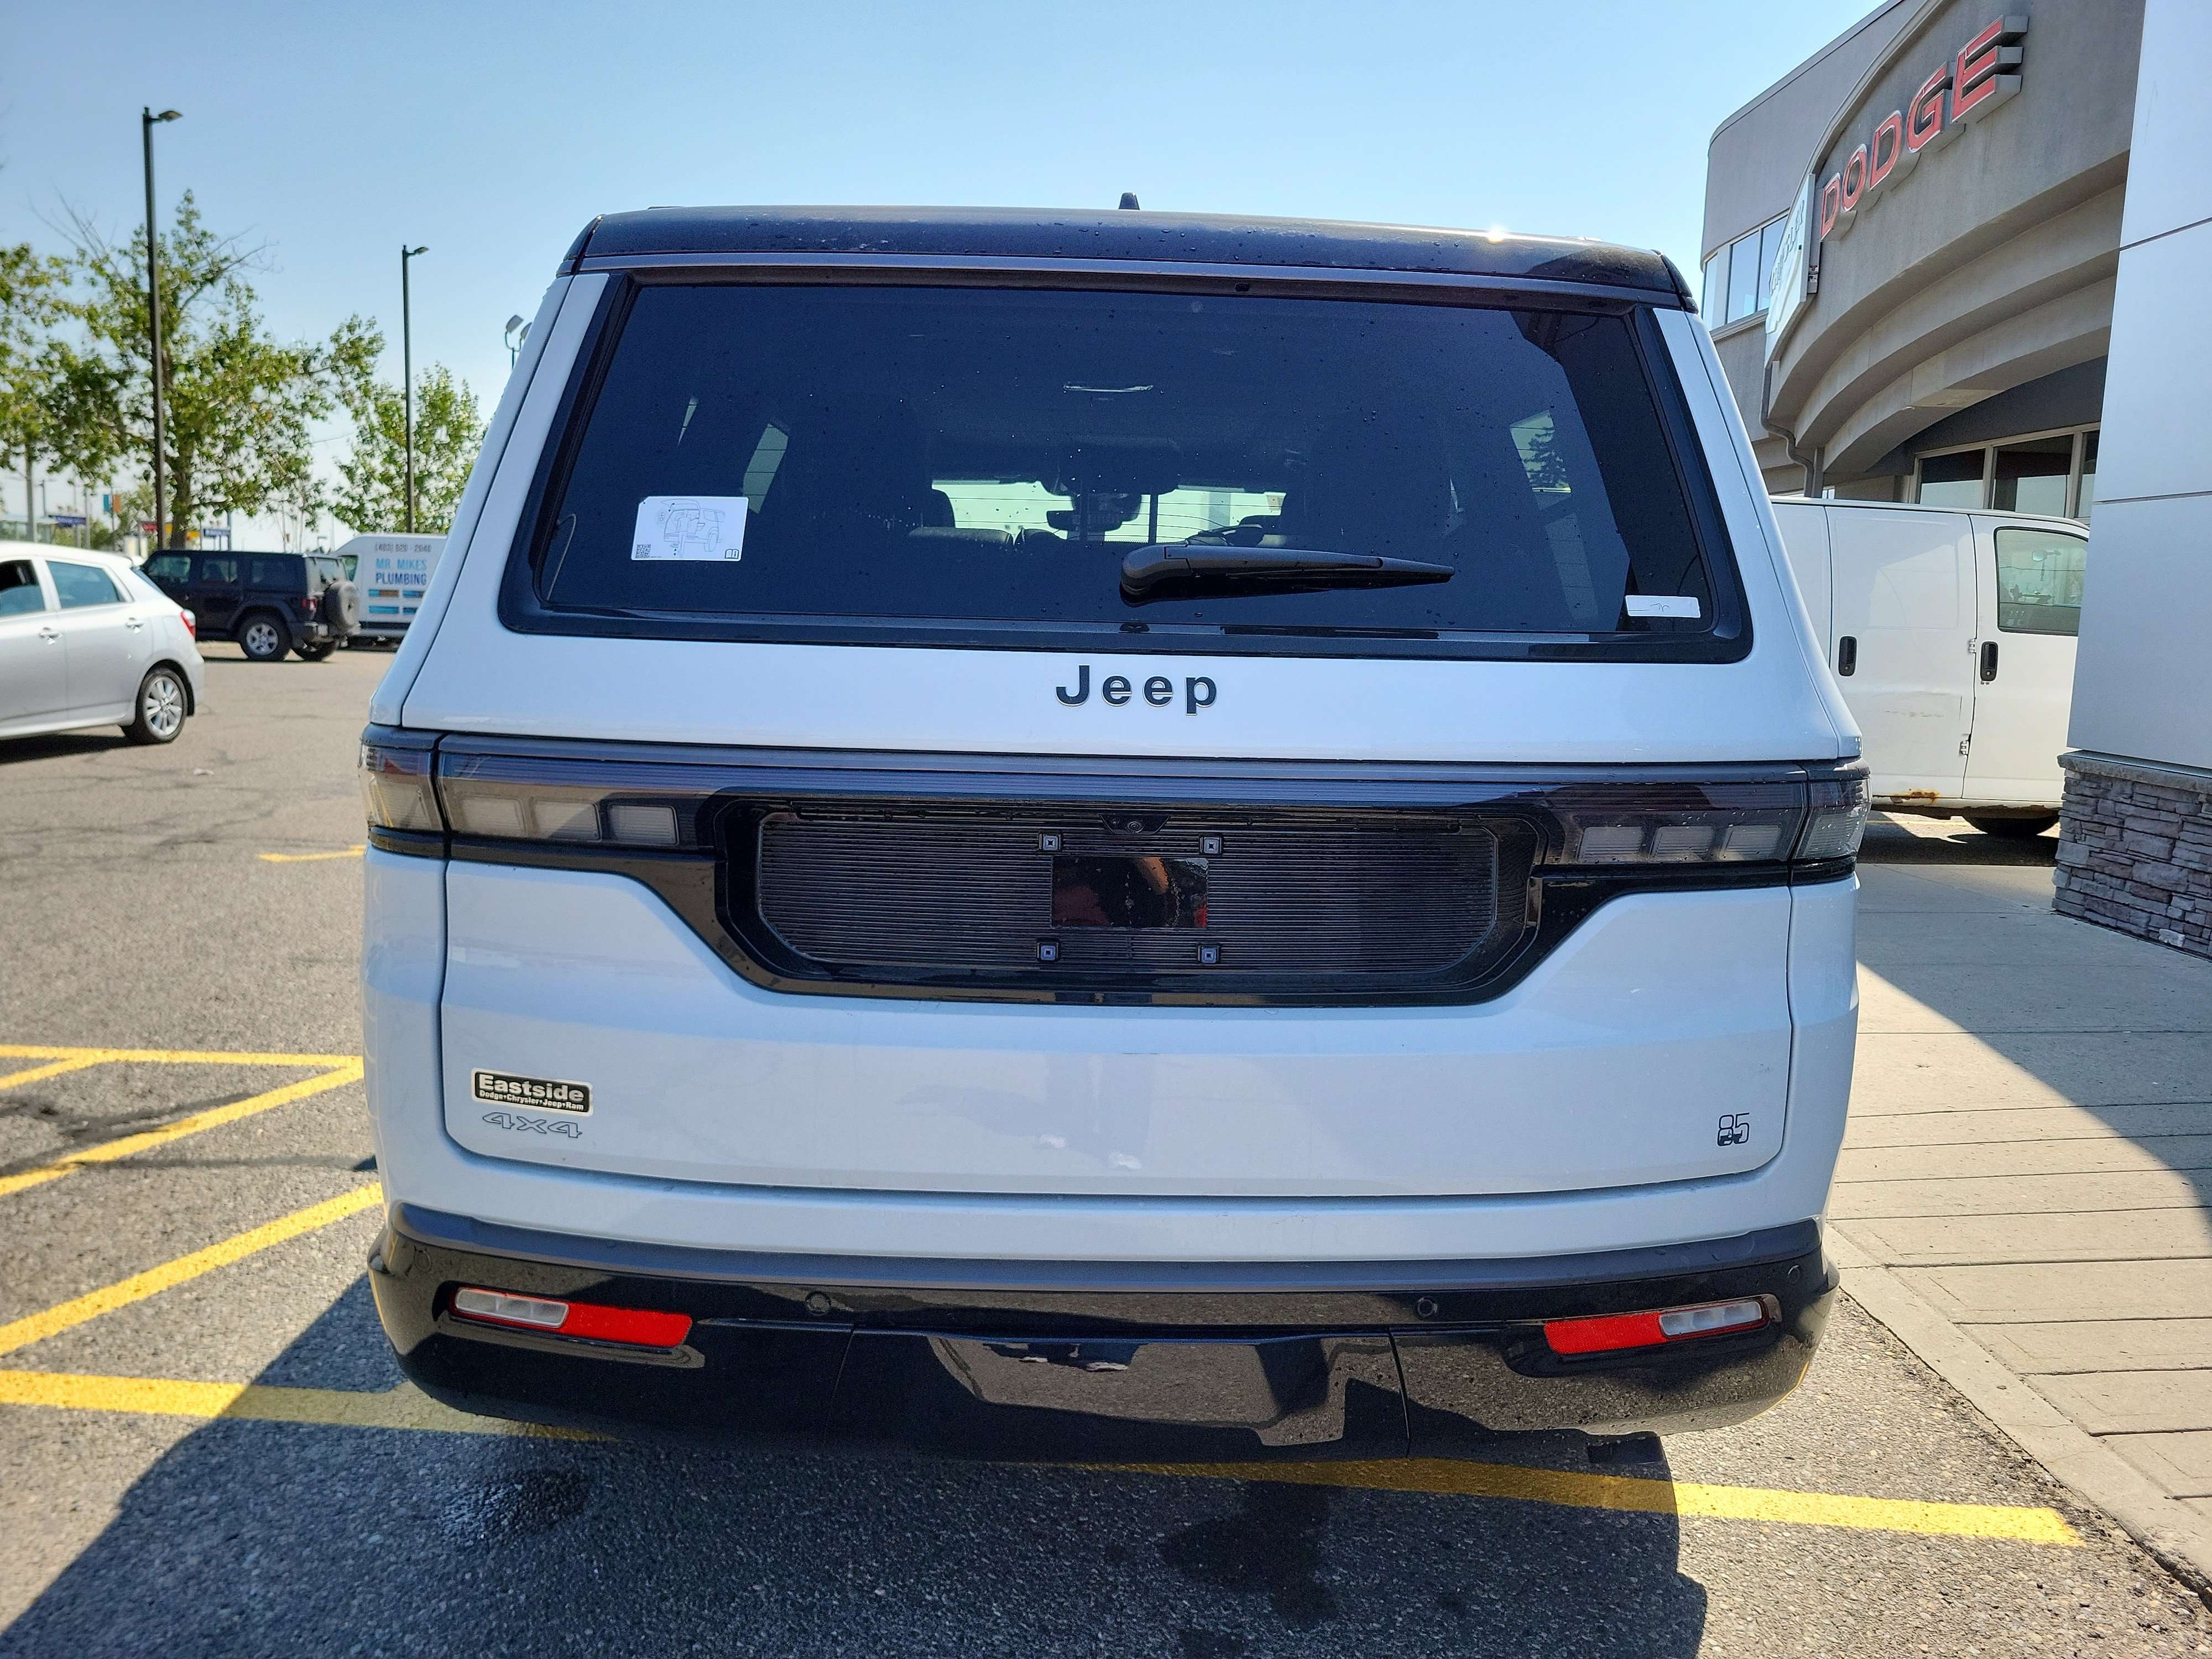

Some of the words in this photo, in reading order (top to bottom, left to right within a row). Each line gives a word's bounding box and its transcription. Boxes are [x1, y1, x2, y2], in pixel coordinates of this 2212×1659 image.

[1819, 15, 2007, 241] DODGE
[375, 572, 427, 585] PLUMBING
[1055, 664, 1217, 716] Jeep
[478, 1073, 584, 1102] Eastside
